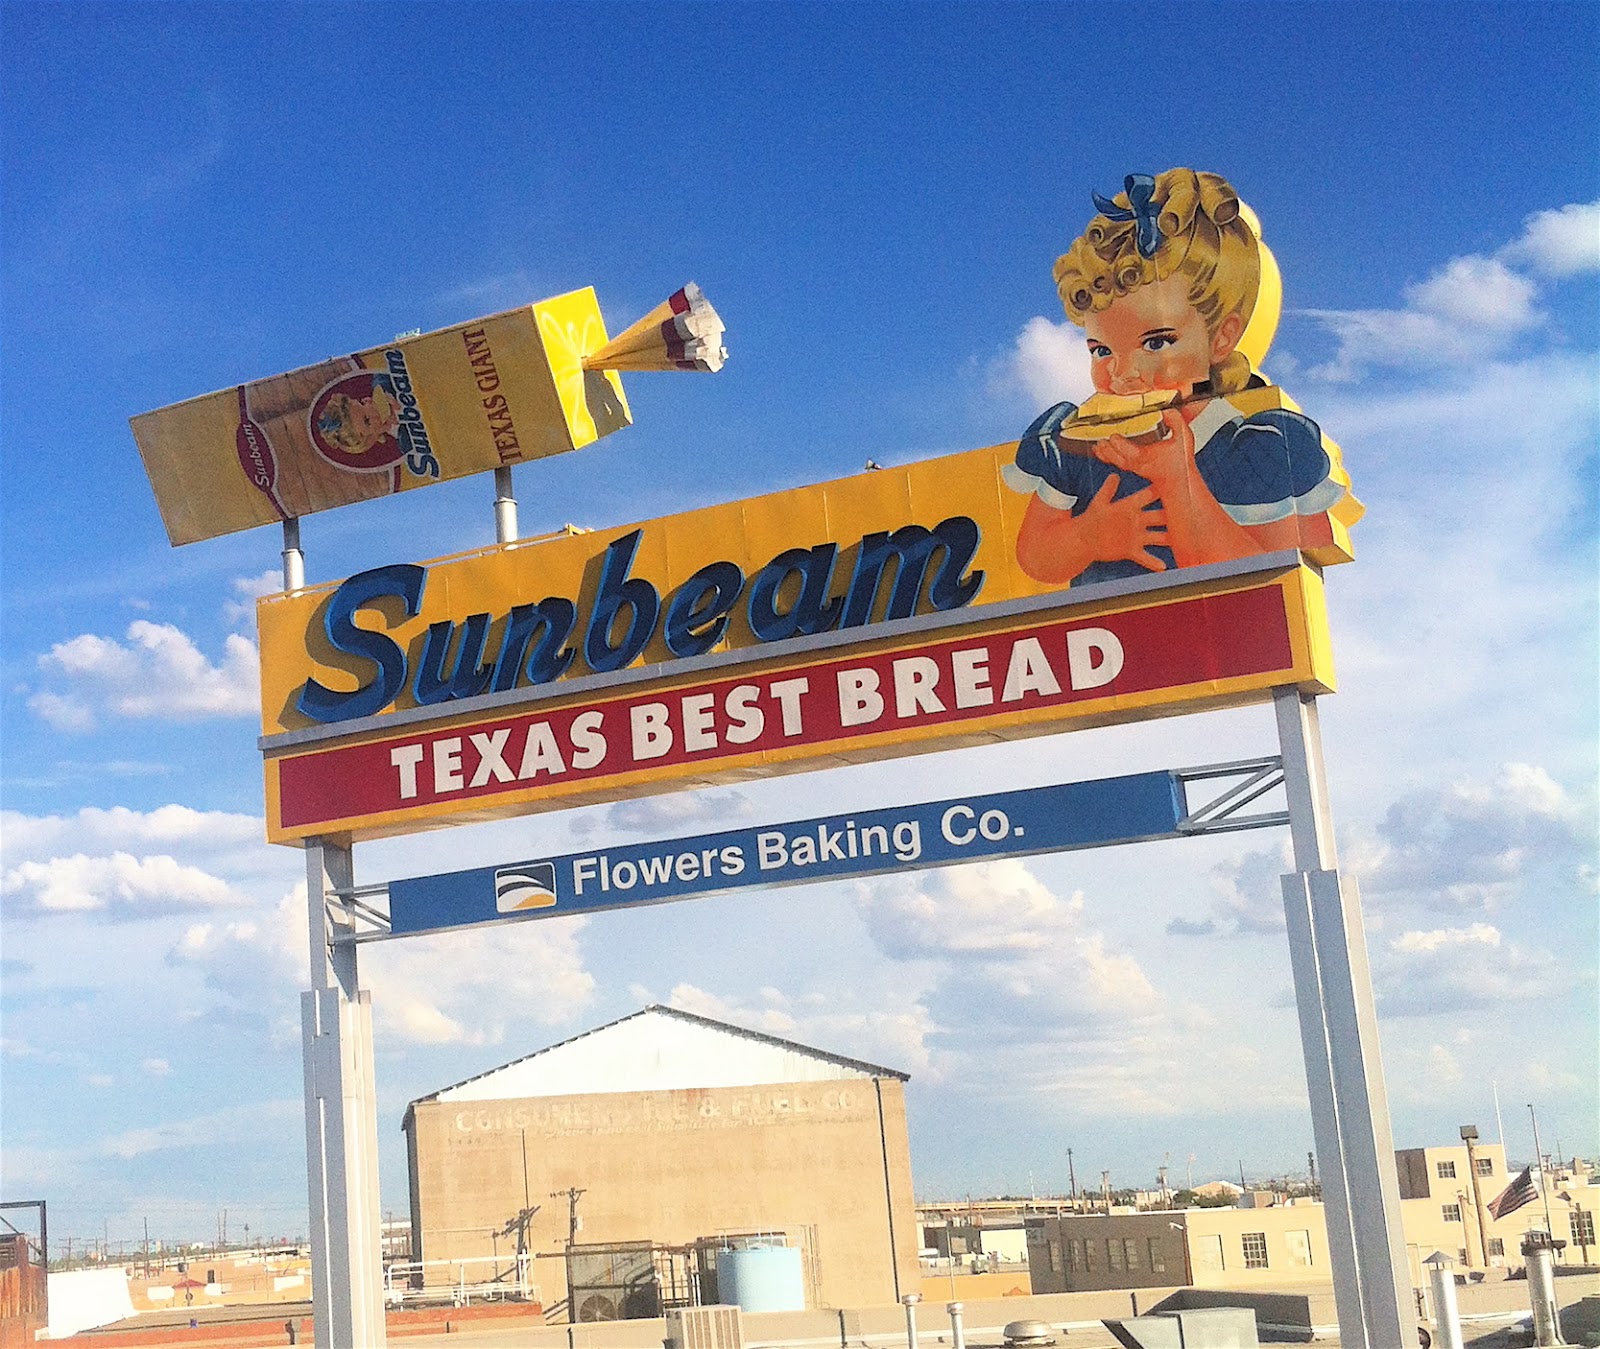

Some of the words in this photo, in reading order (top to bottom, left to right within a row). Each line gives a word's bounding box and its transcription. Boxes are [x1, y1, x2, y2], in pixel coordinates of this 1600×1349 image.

[463, 328, 500, 394] GIANT
[384, 349, 441, 480] Sunbeam
[484, 394, 523, 464] TEXAS
[242, 424, 270, 487] Sunbeam
[296, 515, 986, 724] Sunbeam
[390, 710, 608, 800] TEXAS
[629, 676, 810, 761] BEST
[836, 626, 1125, 728] BREAD
[572, 843, 746, 896] Flowers
[756, 818, 922, 862] Baking
[940, 804, 1026, 846] Co.
[699, 1098, 721, 1118] &
[732, 1092, 810, 1117] FUEL
